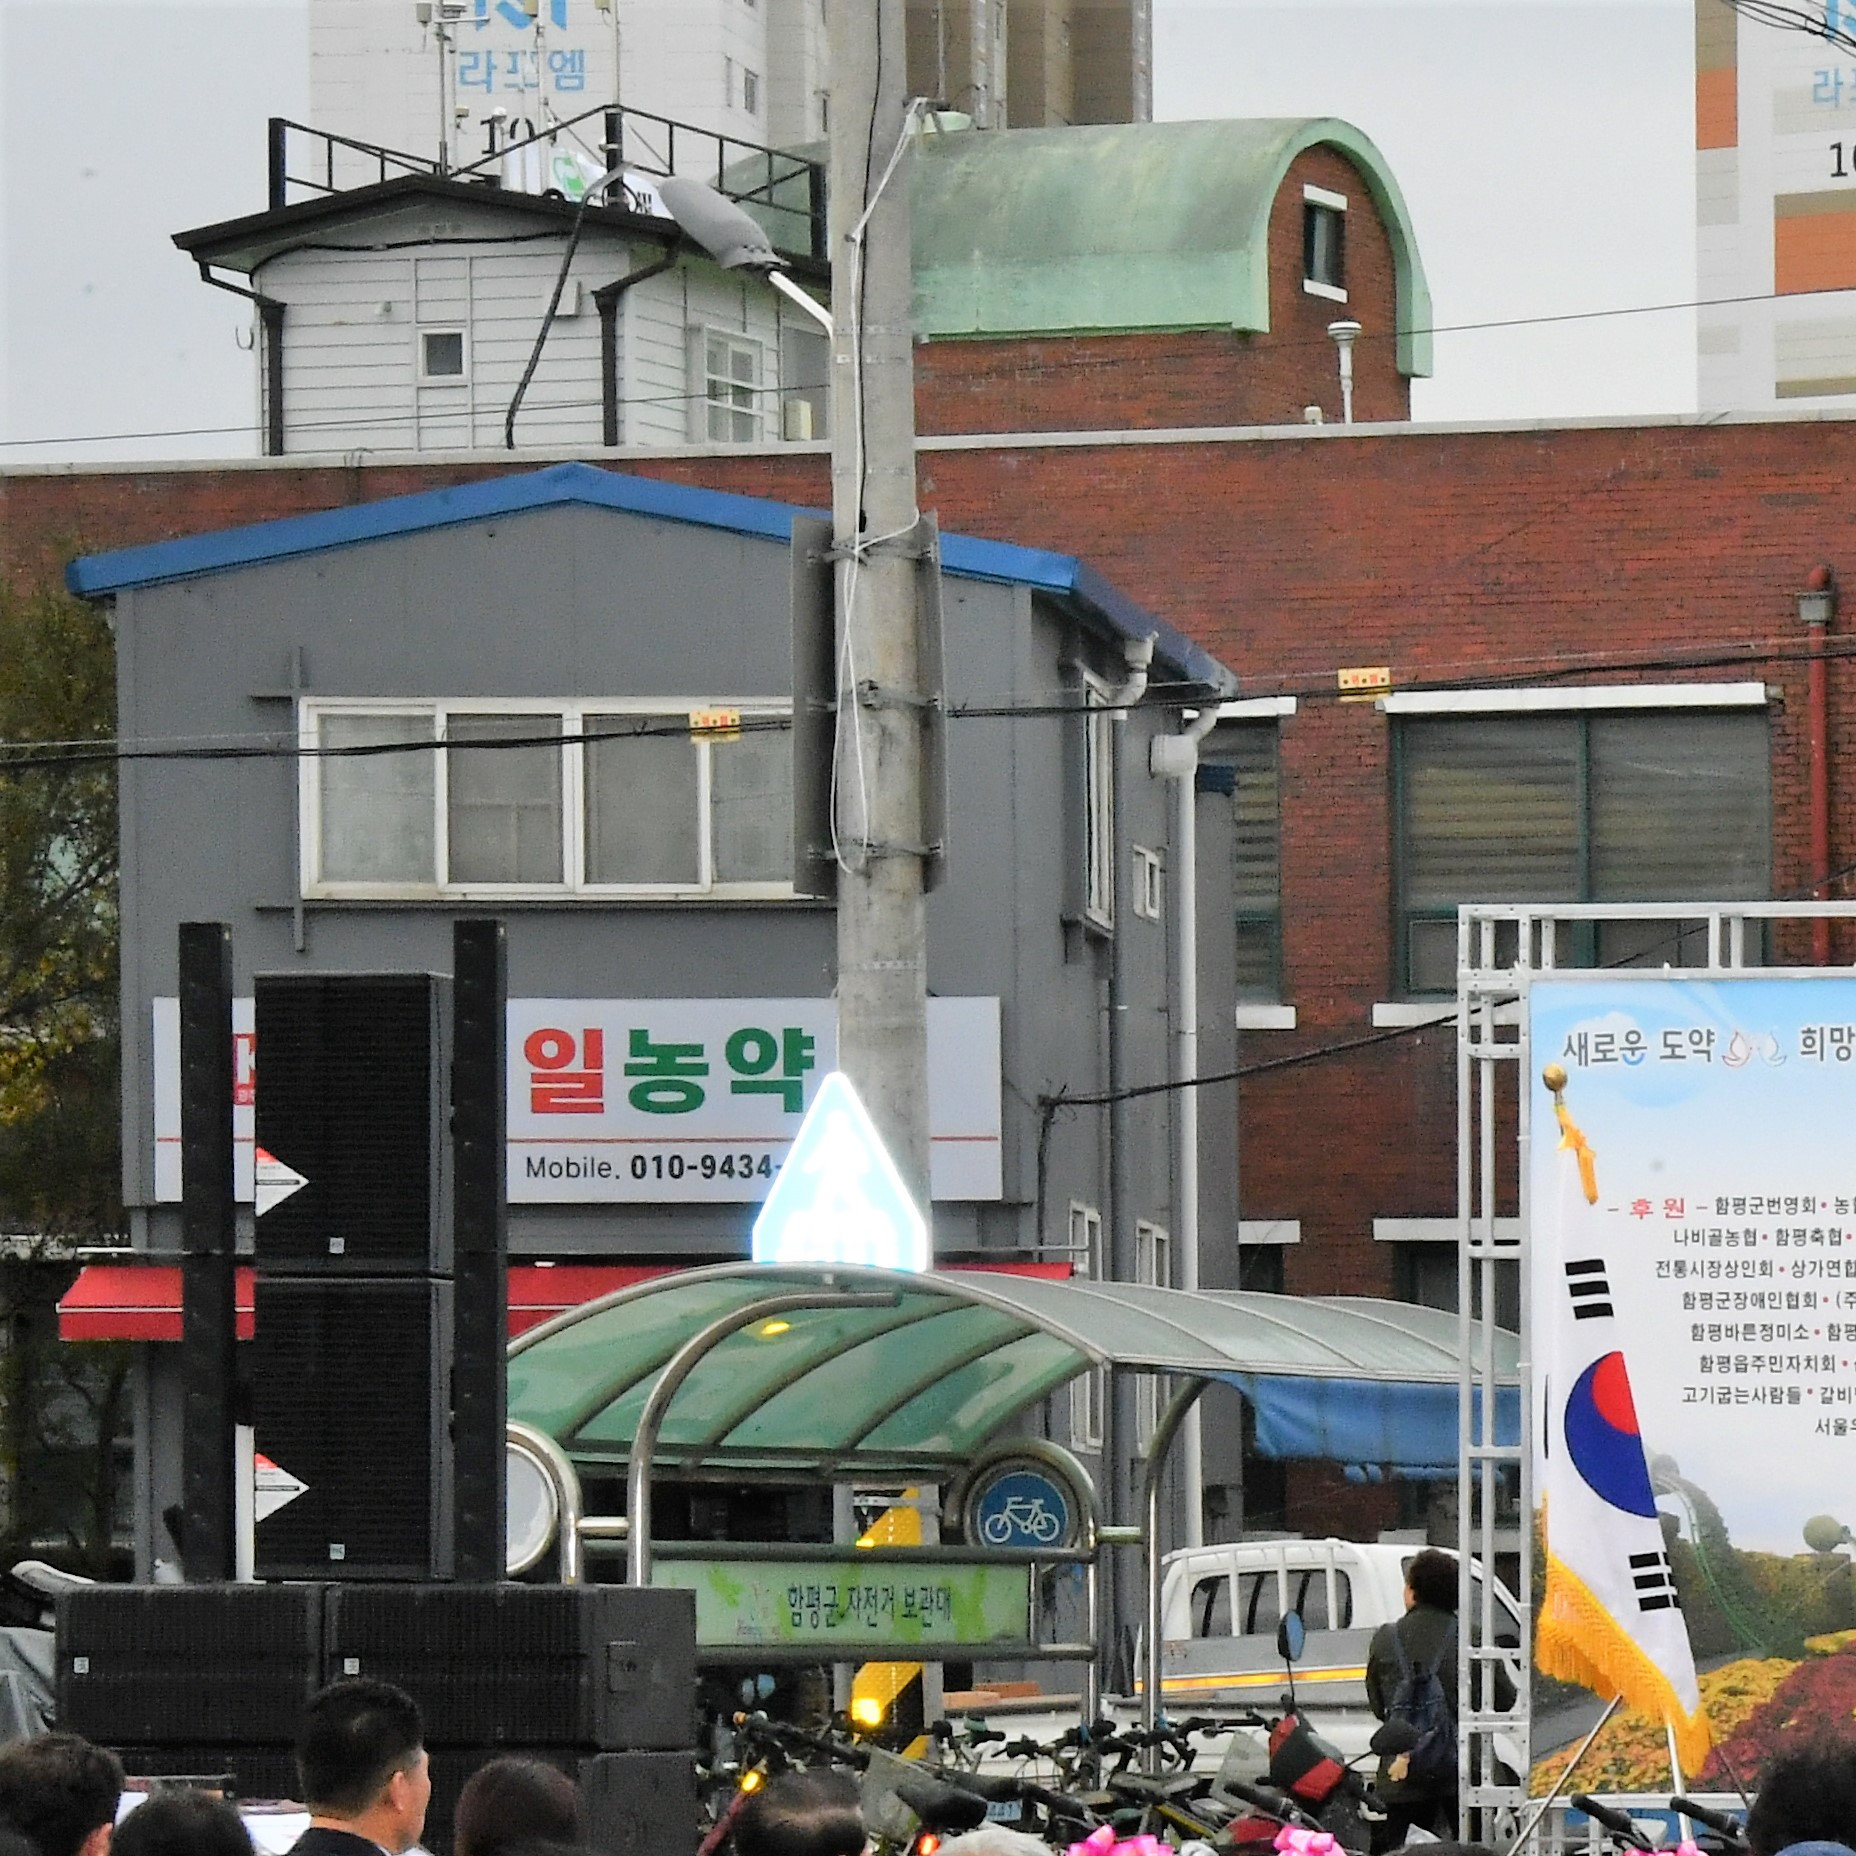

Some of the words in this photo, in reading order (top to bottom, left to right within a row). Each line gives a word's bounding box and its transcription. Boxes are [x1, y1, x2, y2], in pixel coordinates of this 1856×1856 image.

[459, 49, 585, 93] 라포엠
[1563, 1029, 1648, 1068] 새로운
[1659, 1028, 1716, 1064] 도약
[525, 1155, 621, 1181] Mobile.
[1715, 1196, 1816, 1216] 함평군번영회
[1674, 1228, 1757, 1248] 나비골농협
[1776, 1228, 1842, 1247] 함평축협
[1655, 1259, 1774, 1279] 전통시장상인회
